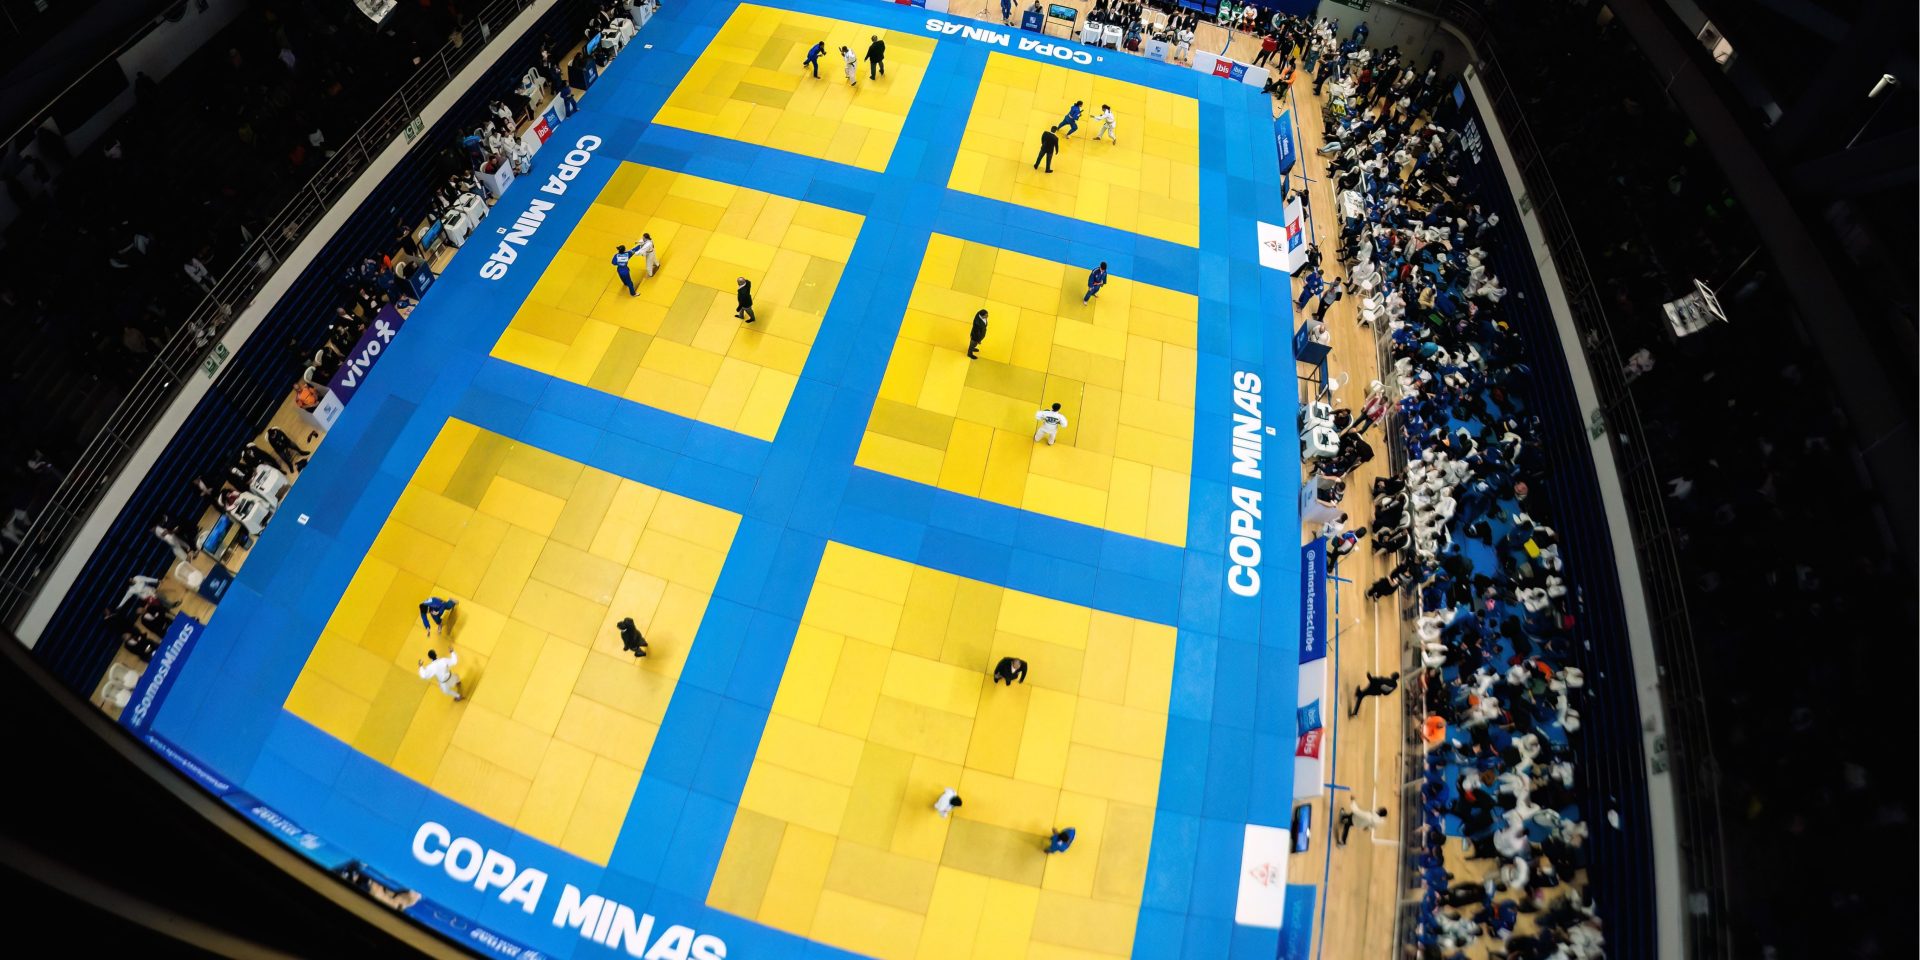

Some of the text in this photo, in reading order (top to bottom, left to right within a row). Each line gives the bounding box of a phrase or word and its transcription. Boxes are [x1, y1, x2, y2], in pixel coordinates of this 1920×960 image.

[925, 18, 1094, 66] COPA MINAS
[1216, 64, 1229, 74] ibis
[537, 125, 550, 138] ibis
[479, 134, 602, 281] COPA MINAS
[341, 340, 381, 387] vivo
[1227, 370, 1262, 597] COPA MINAS
[1305, 549, 1316, 652] @minastenisclube
[131, 623, 194, 728] #SomosMinas
[412, 820, 727, 960] COPA MINAS
